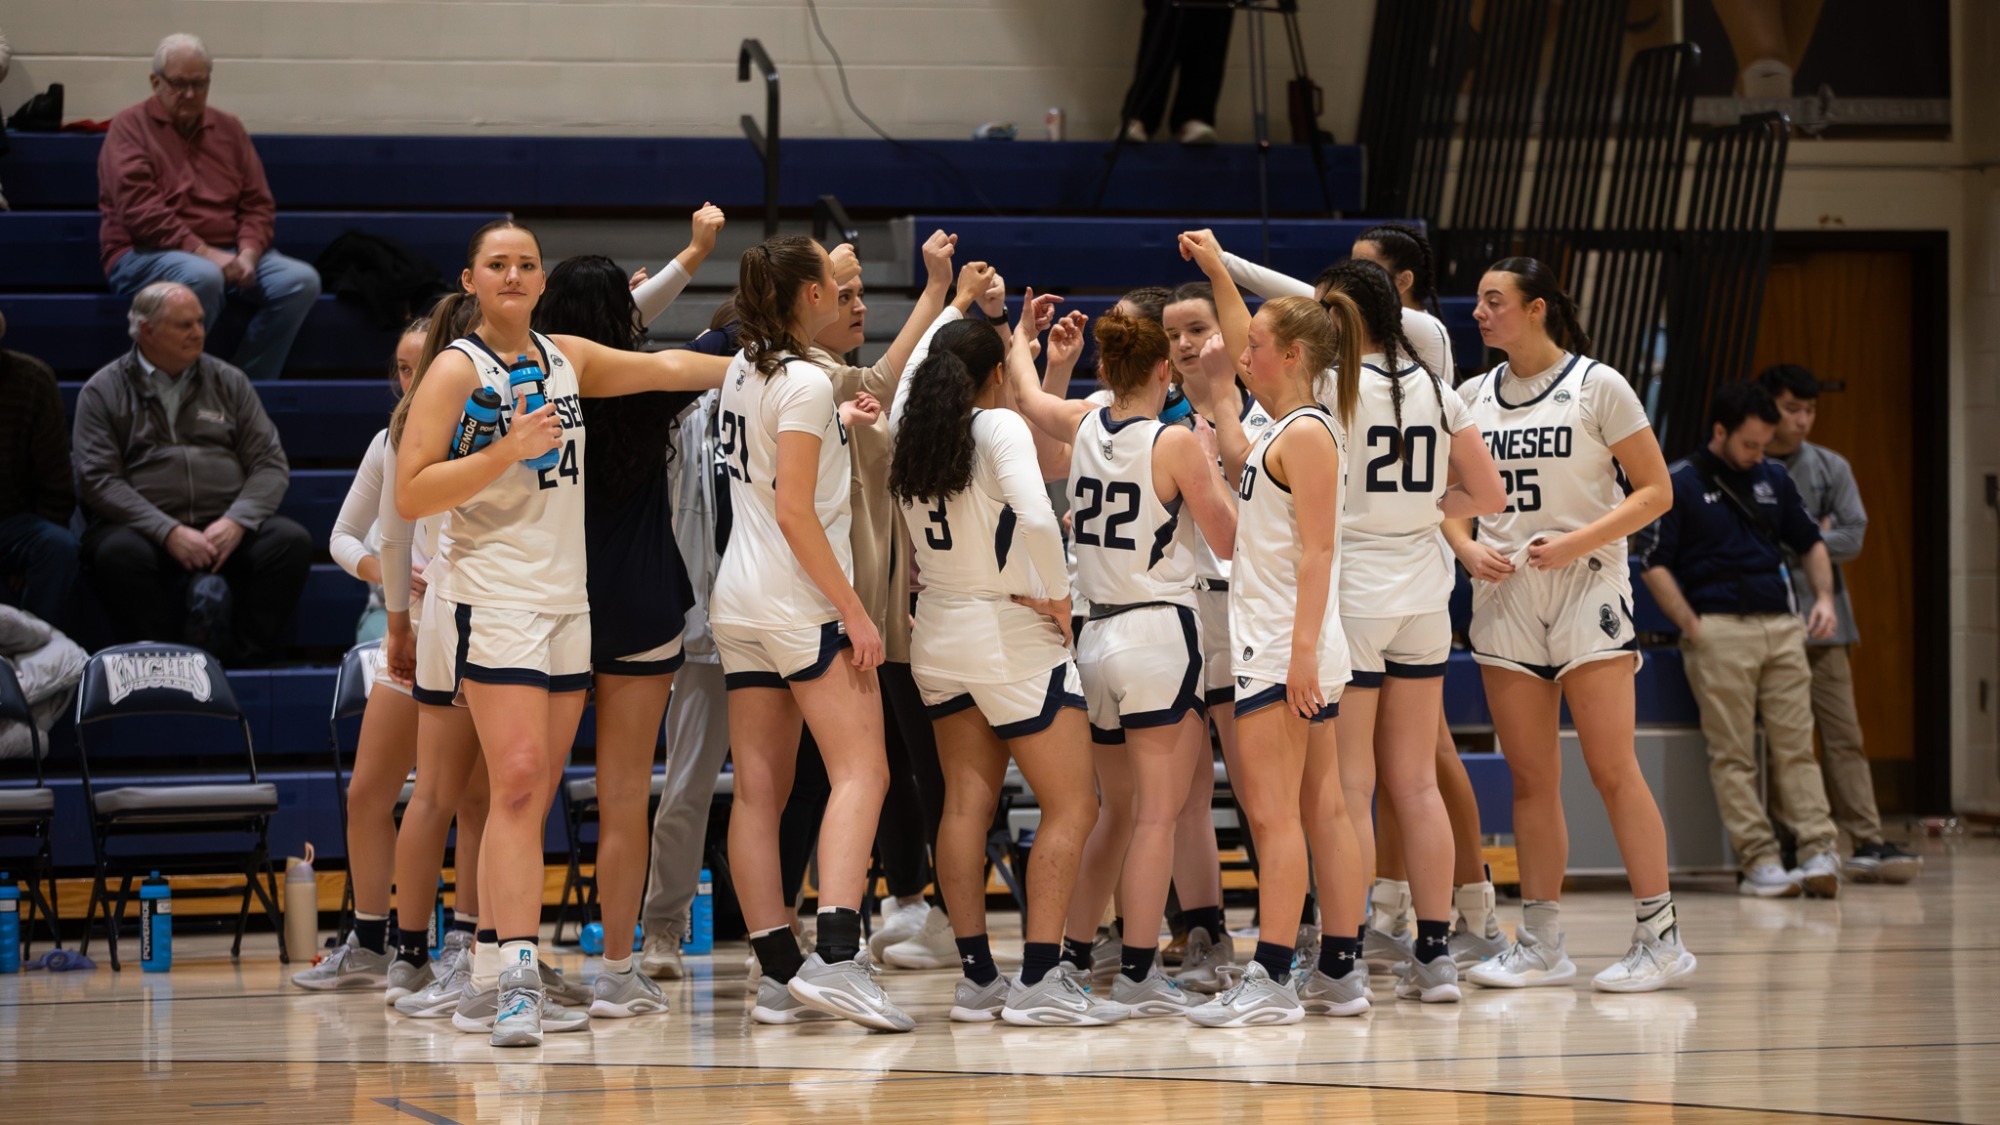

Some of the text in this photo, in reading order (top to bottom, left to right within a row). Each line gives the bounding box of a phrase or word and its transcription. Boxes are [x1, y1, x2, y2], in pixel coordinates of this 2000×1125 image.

[458, 417, 478, 456] POWER
[721, 410, 753, 484] 21
[1365, 425, 1437, 493] 20
[1075, 475, 1141, 551] 22
[101, 651, 212, 706] KNIGHTS
